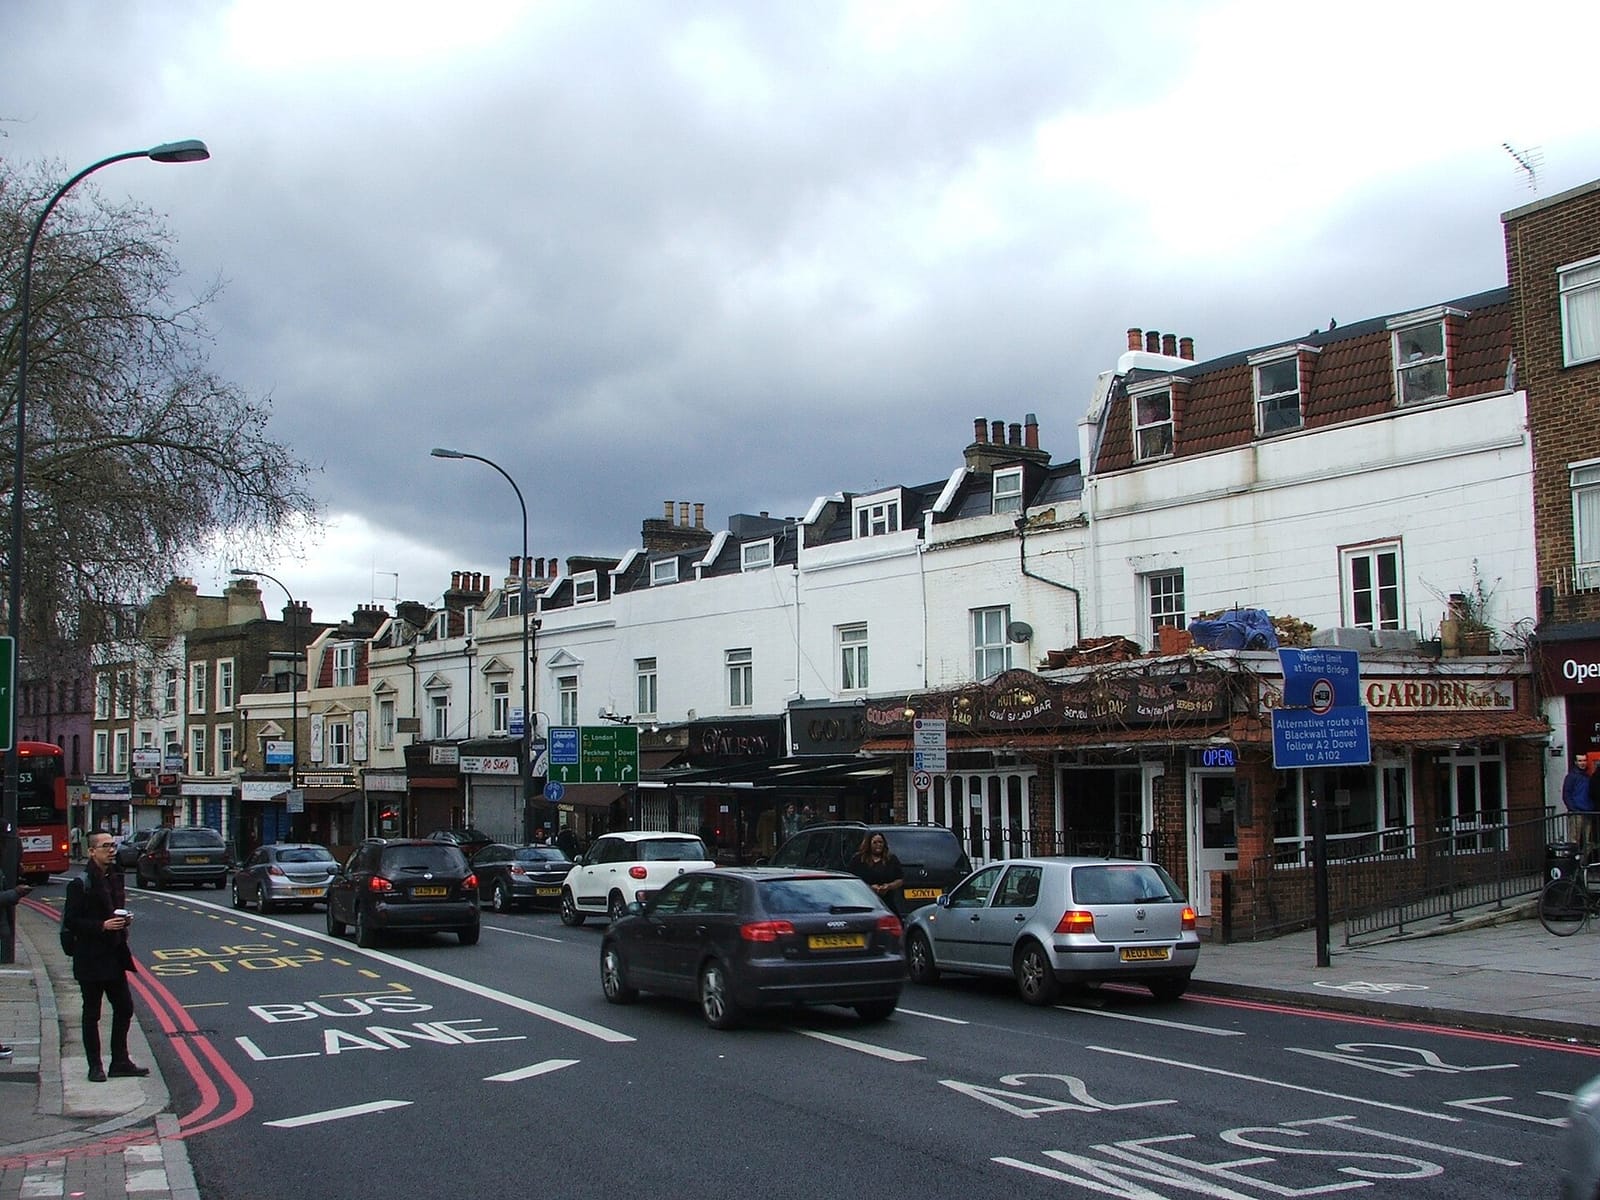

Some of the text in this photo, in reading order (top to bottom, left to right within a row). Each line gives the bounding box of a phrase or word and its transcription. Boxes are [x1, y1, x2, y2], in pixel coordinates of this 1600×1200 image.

[1298, 653, 1342, 664] Weight limit
[1304, 664, 1325, 673] Tower
[1327, 665, 1349, 676] Bridge
[1366, 683, 1468, 707] GARDEN
[1034, 700, 1052, 716] BAR
[1276, 717, 1364, 729] Alternative route via
[1285, 728, 1358, 740] Blackwall Tunnel
[1286, 740, 1357, 751] follow A2 Dover
[1305, 751, 1340, 761] to A102
[916, 776, 929, 786] 20
[152, 944, 279, 961] BUS
[151, 955, 324, 976] STOP
[248, 996, 433, 1023] BUS
[235, 1019, 527, 1061] LANE
[1284, 1041, 1520, 1078] A2
[938, 1072, 1180, 1118] A2
[990, 1115, 1523, 1200] WEST
